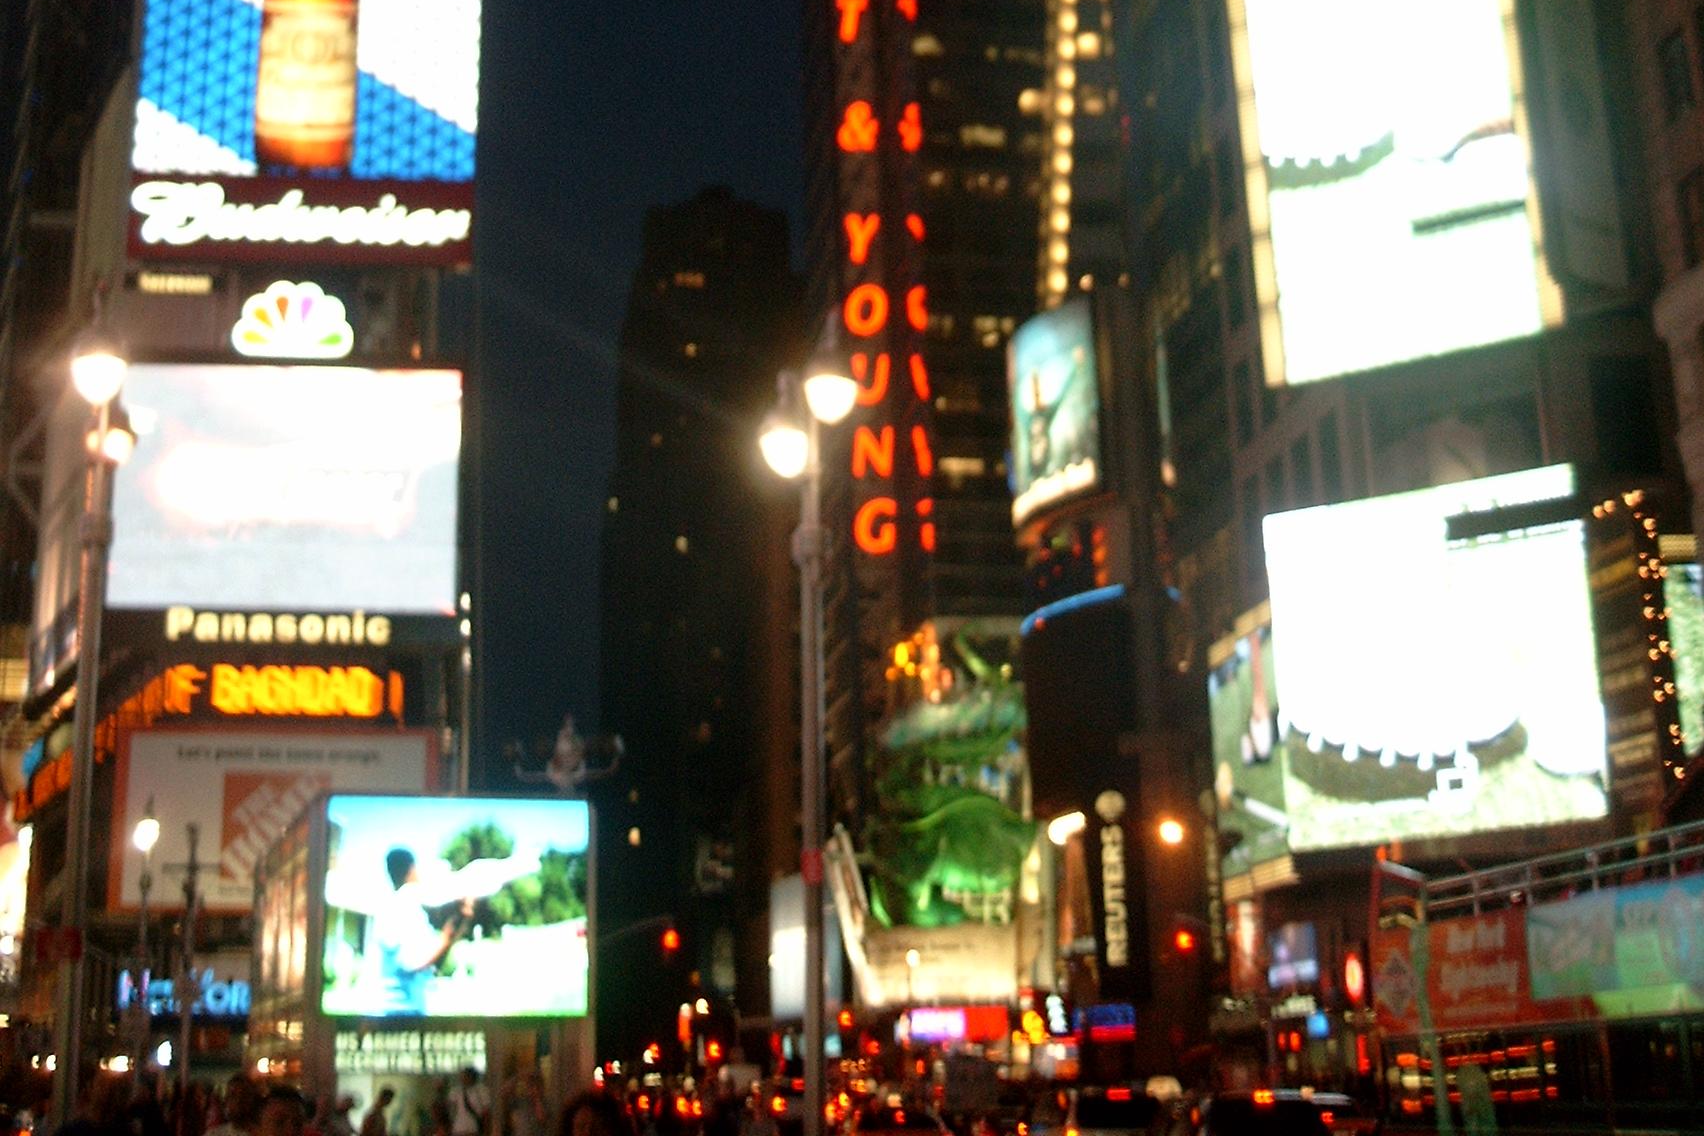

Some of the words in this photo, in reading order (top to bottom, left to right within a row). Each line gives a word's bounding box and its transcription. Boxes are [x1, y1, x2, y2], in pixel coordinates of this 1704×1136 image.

[130, 180, 472, 246] Budweiser
[842, 211, 898, 556] YOUNG
[165, 604, 394, 647] Panasonic
[210, 662, 386, 720] BAGHDAD
